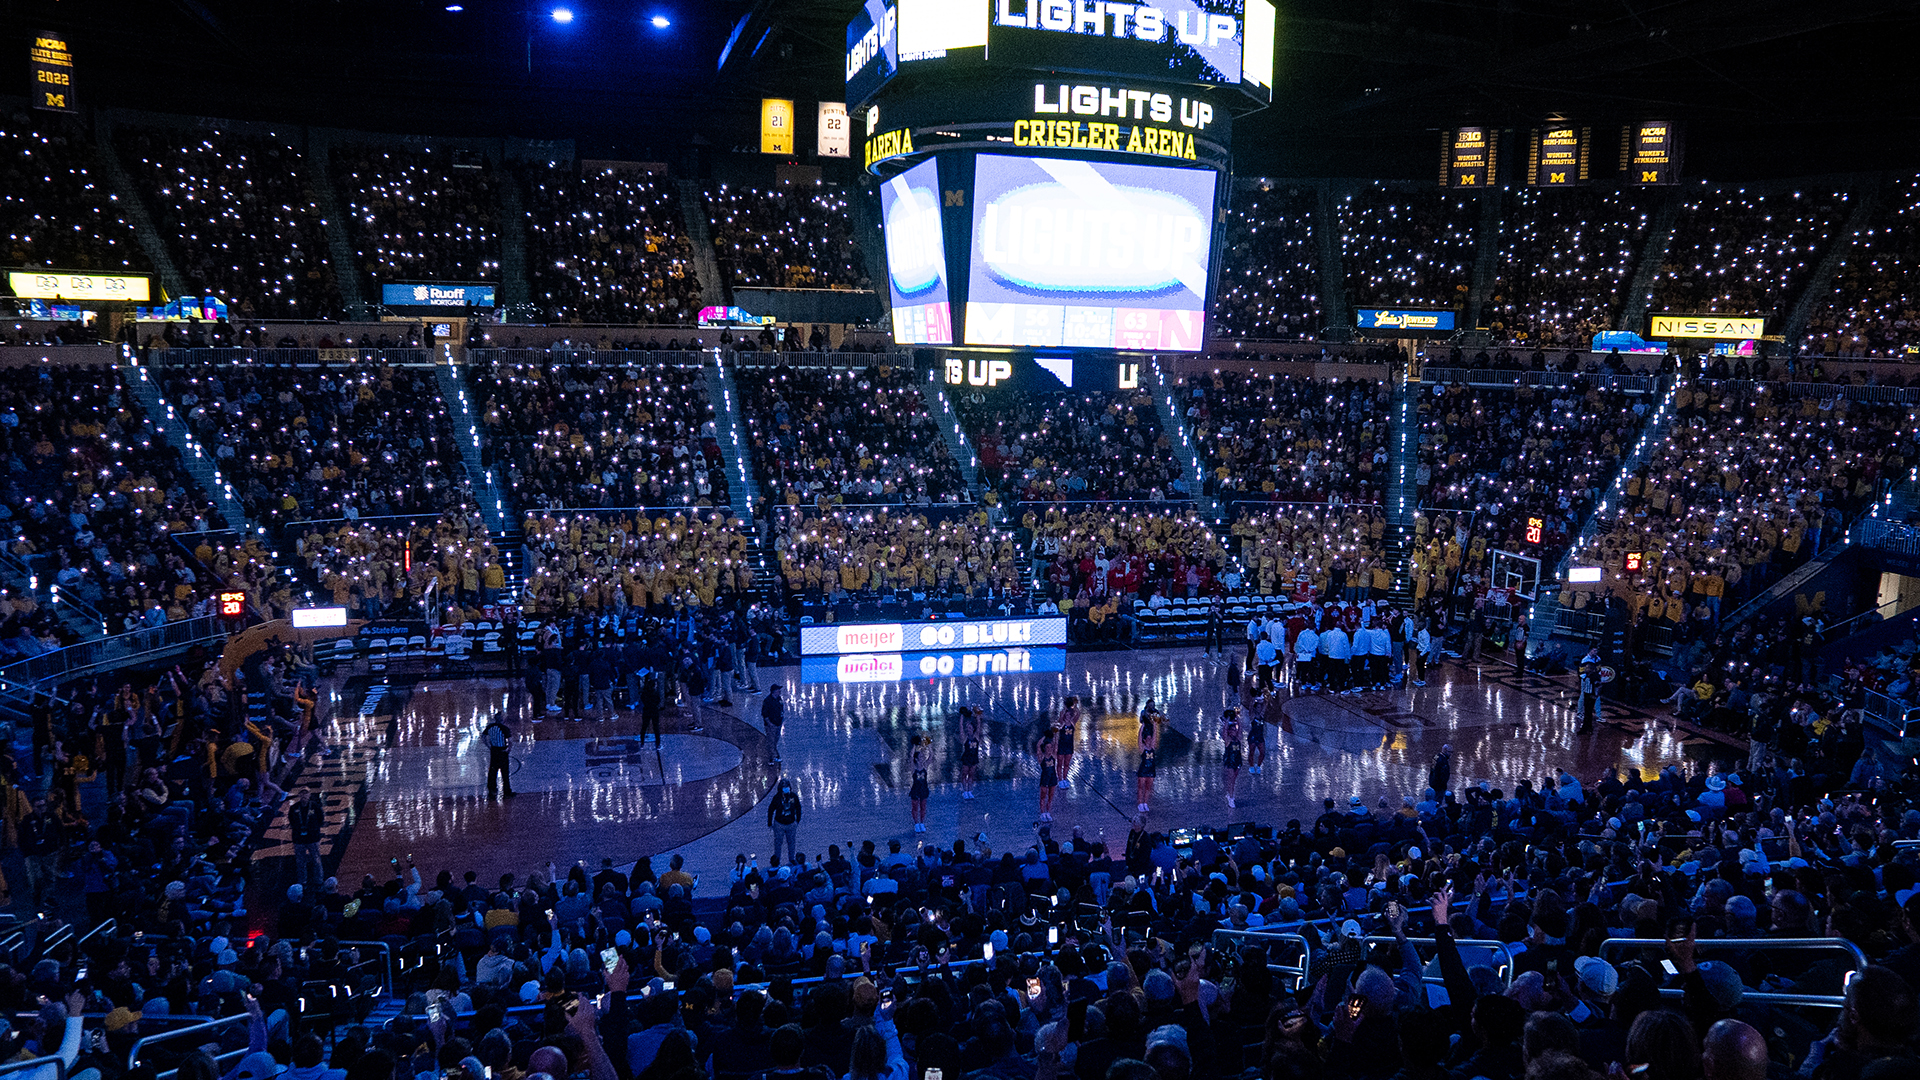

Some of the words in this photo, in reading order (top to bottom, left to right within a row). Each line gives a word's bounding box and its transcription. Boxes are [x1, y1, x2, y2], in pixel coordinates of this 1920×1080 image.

[998, 0, 1166, 42] LIGHTS
[1178, 10, 1237, 48] UP
[36, 37, 67, 51] NCAA
[847, 24, 879, 82] LIGHTS
[879, 5, 897, 48] UP
[37, 70, 70, 86] 2022
[45, 92, 66, 108] M
[1034, 84, 1173, 123] LIGHTS
[1180, 98, 1214, 130] UP
[772, 116, 783, 127] 21
[827, 118, 841, 130] 22
[866, 104, 879, 136] P
[1014, 119, 1120, 150] CRISLER
[1126, 126, 1197, 160] ARENA
[1548, 129, 1573, 138] NCAA
[1640, 127, 1666, 136] NCAA
[773, 144, 782, 152] M
[872, 128, 914, 162] ARENA
[1461, 174, 1476, 185] M
[1550, 172, 1566, 184] M
[1642, 171, 1658, 183] M
[945, 189, 964, 207] M
[984, 203, 1137, 270] LIGHTS
[1142, 213, 1203, 271] UP
[430, 288, 465, 299] Ruoff
[1025, 308, 1050, 326] 56
[1124, 312, 1148, 330] 63
[1658, 321, 1757, 335] NISSAN
[969, 359, 1012, 386] UP
[1527, 527, 1541, 544] 20
[223, 602, 240, 614] 20
[845, 628, 895, 648] meijer
[920, 625, 955, 646] GO
[962, 622, 1031, 645] BLUE!
